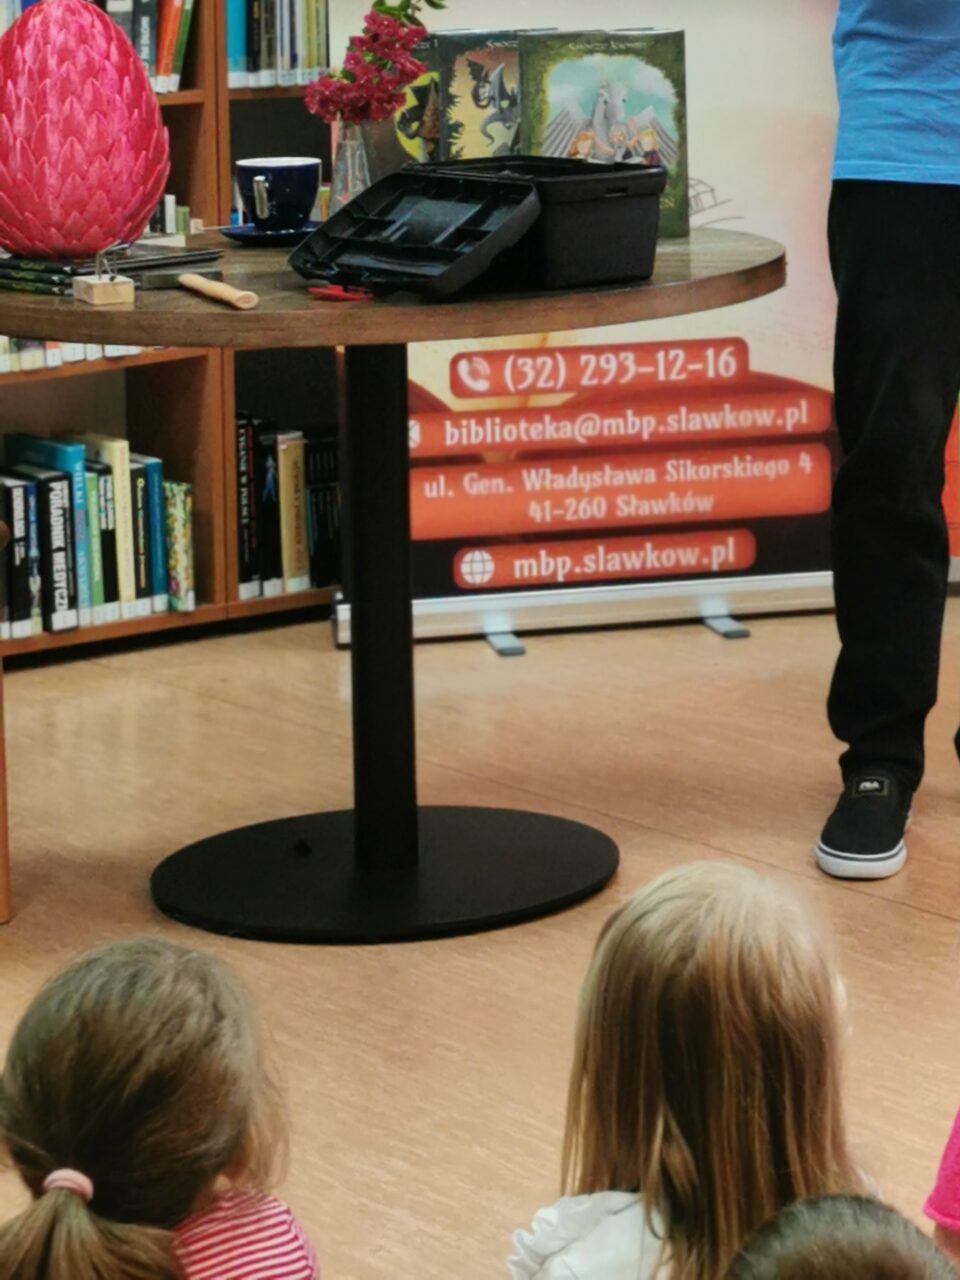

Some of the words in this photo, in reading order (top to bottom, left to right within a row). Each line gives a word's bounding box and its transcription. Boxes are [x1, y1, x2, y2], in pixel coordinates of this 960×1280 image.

[504, 353, 566, 391] (32)
[580, 346, 736, 385] 293-12-16
[444, 400, 808, 446] biblioteka@mbp.slawkow.pl
[424, 475, 454, 498] ul.
[463, 471, 513, 496] Gen.
[522, 466, 656, 501] Władysława
[665, 456, 789, 482] Sikorskiego
[798, 453, 812, 473] 4
[48, 481, 65, 549] PORADNIK
[528, 497, 606, 524] 41-260
[616, 491, 714, 519] Sławków
[513, 536, 735, 581] mbp.slawkow.pl
